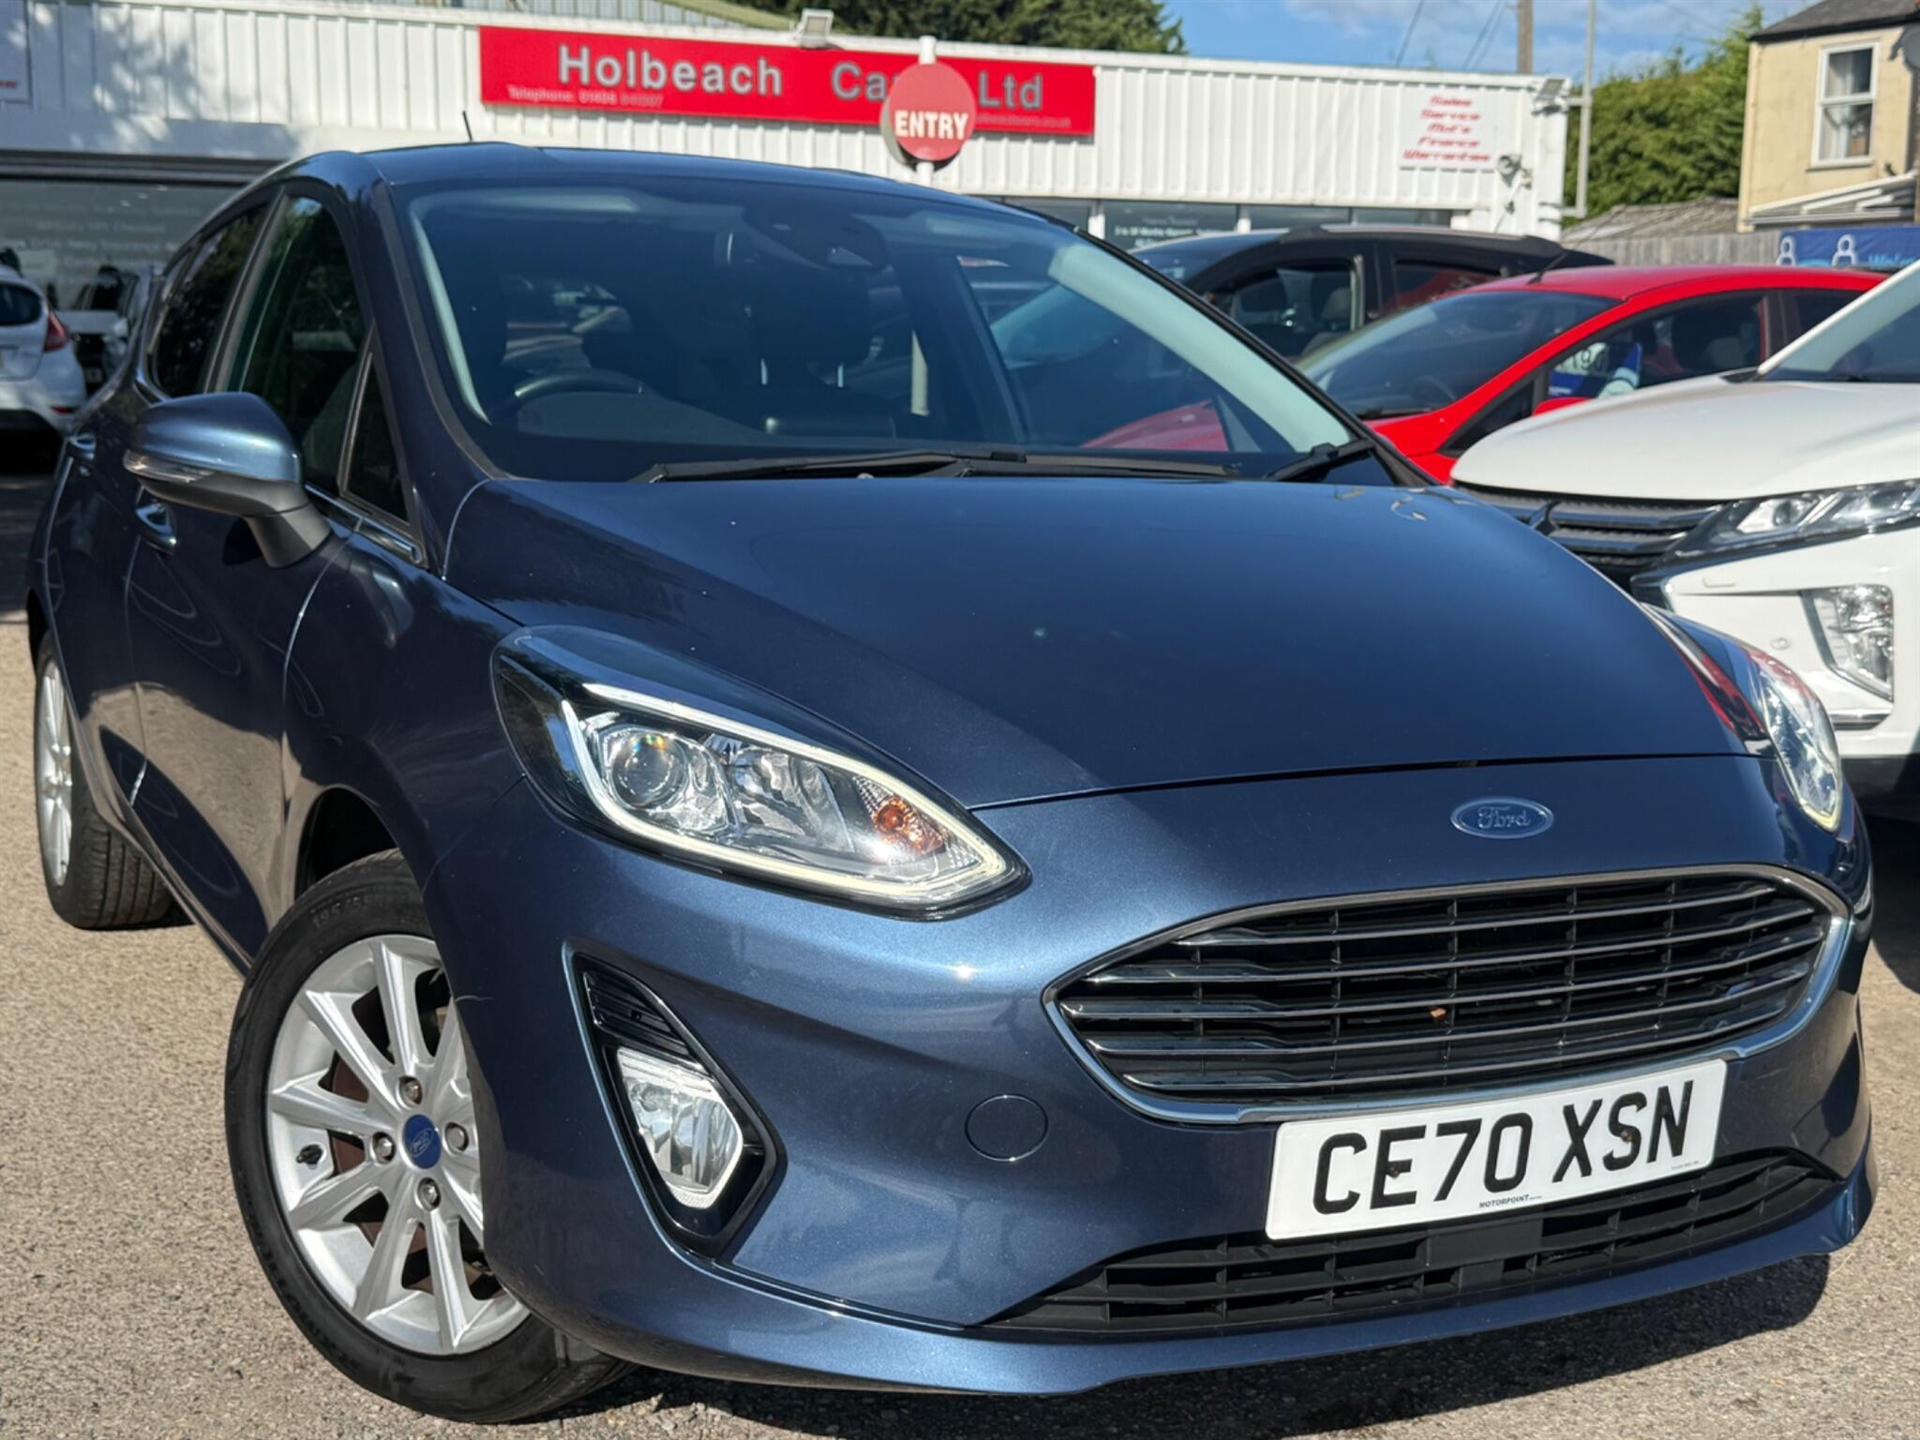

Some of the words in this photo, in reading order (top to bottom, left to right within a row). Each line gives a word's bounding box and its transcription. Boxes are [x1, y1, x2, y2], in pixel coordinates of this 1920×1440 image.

[558, 44, 782, 96] Holbeach
[978, 70, 1043, 109] Ltd
[894, 110, 969, 140] ENTRY
[1478, 805, 1531, 829] Ford
[1313, 1112, 1533, 1215] CE70
[1552, 1080, 1694, 1184] XSN
[1479, 1194, 1529, 1208] MOTORPOINT
